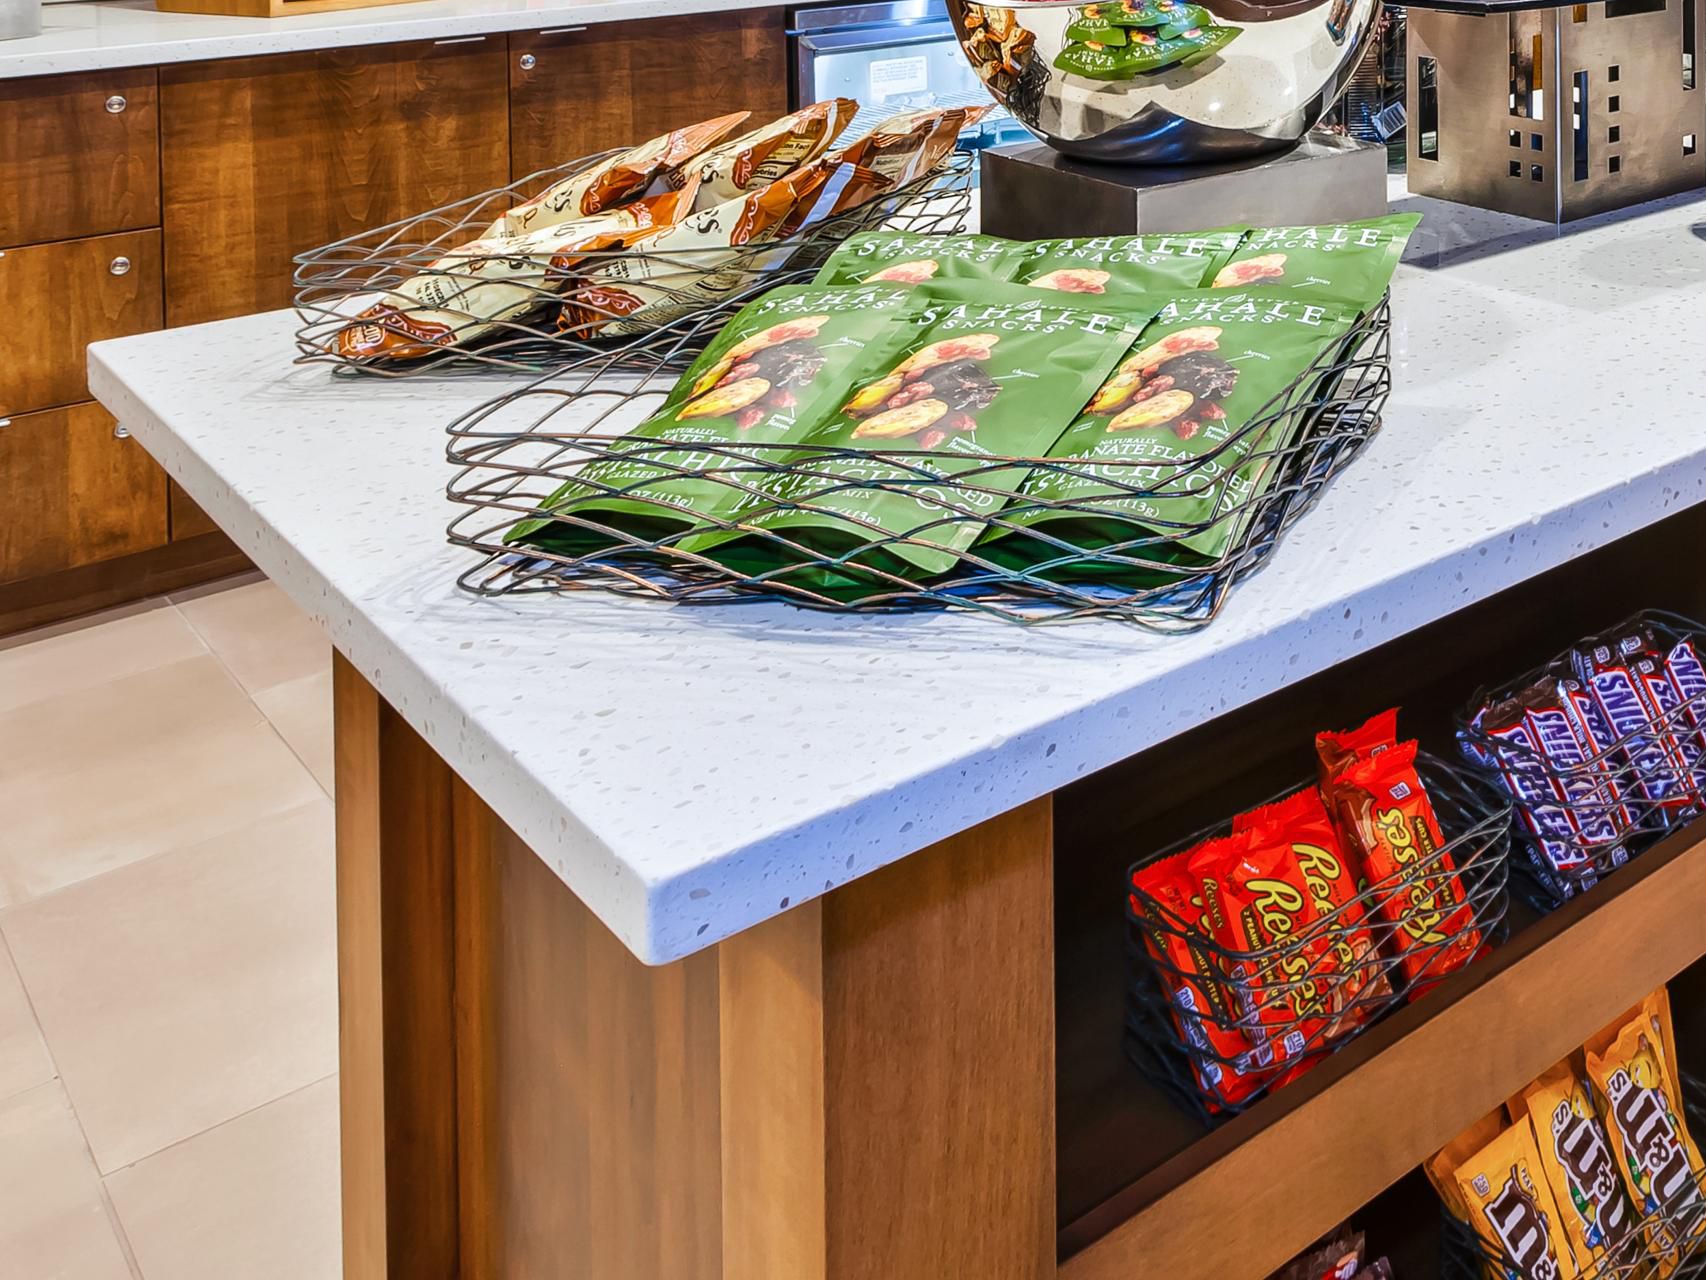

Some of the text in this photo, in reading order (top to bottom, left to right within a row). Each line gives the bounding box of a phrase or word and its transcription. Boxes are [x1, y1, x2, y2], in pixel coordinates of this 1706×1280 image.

[1240, 226, 1381, 248] HALE
[858, 238, 1006, 256] SAHAL
[884, 247, 992, 262] SNACKS
[1030, 237, 1209, 259] SAHALE
[1054, 249, 1162, 265] SNACKS
[758, 290, 906, 315] SAHAL
[778, 300, 888, 314] SNACKS
[918, 303, 1115, 335] SAHALE
[1159, 312, 1278, 326] SNACKS
[1160, 299, 1327, 327] AHALE
[943, 318, 1060, 333] SNACKS
[1100, 438, 1158, 447] NATURALLY
